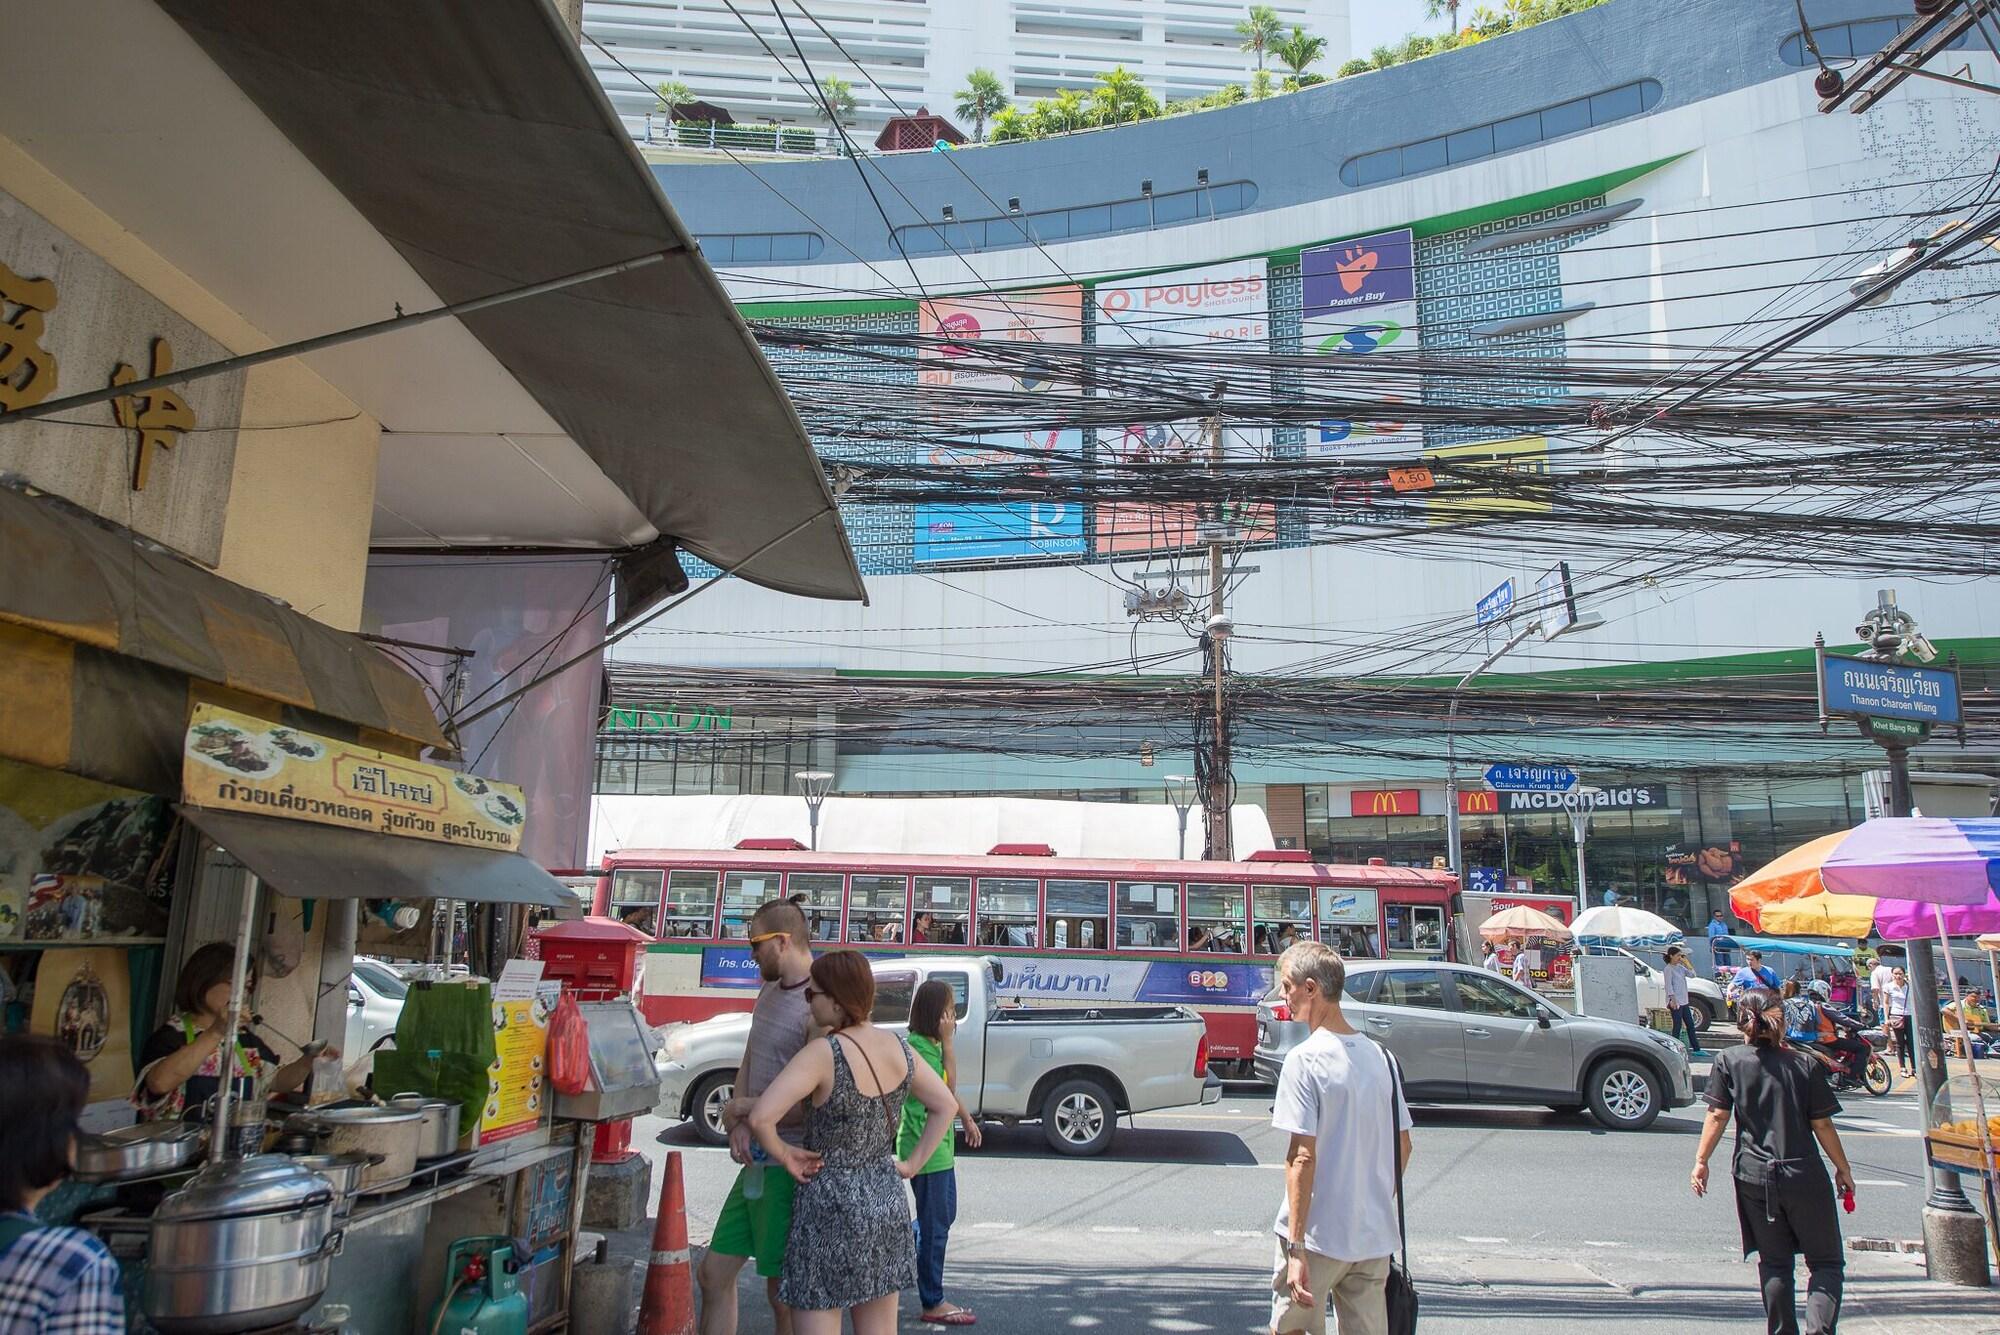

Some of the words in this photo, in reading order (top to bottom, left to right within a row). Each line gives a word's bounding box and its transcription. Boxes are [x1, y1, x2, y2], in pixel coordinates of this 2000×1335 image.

[1144, 274, 1264, 308] Payless
[1330, 296, 1363, 306] Power
[1365, 292, 1385, 301] Buy
[1209, 325, 1263, 341] MORE
[1396, 472, 1426, 485] 4.50
[1030, 539, 1081, 549] ROBINSON
[1843, 668, 1940, 698] ถนนเจริญเวียง
[1851, 694, 1880, 707] Thanon
[1881, 698, 1913, 711] Charoen
[1914, 702, 1937, 715] Wiang
[1873, 721, 1889, 730] Khet
[1889, 722, 1906, 733] Bang
[1907, 724, 1920, 734] Rak
[1529, 782, 1551, 790] Krung
